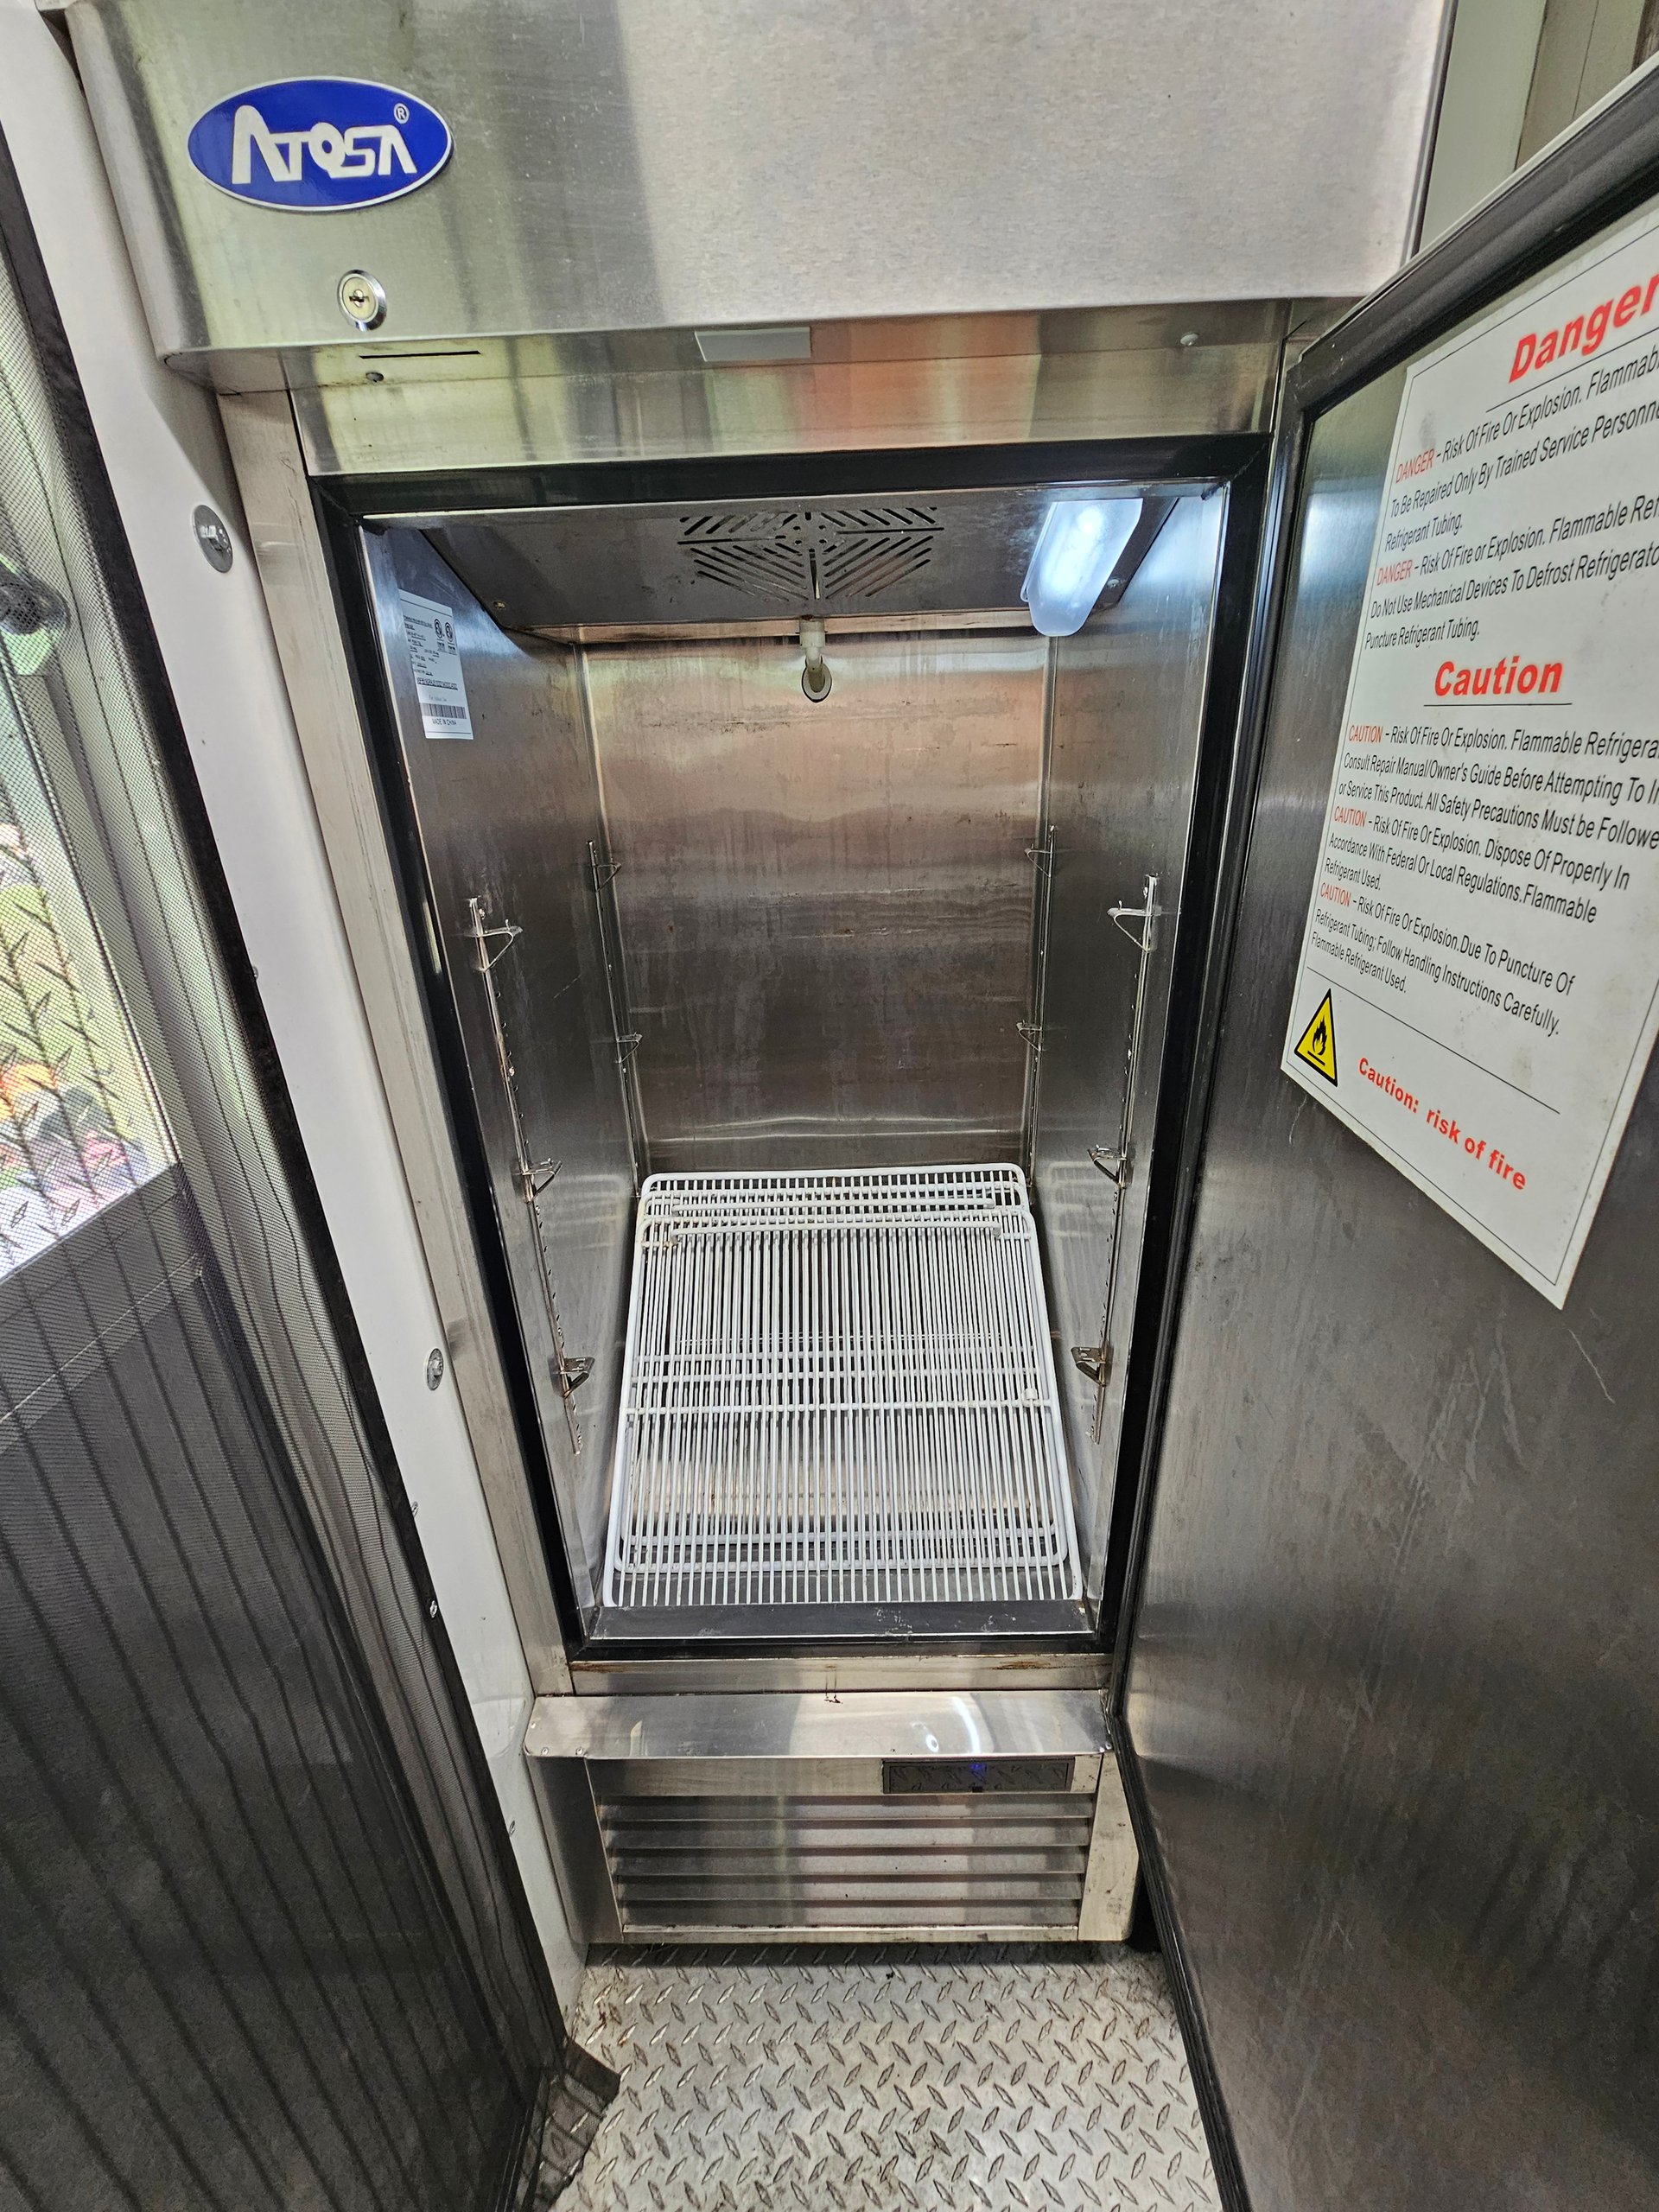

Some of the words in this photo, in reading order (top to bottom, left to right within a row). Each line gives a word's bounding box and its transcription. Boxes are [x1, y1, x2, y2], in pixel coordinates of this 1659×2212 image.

[232, 105, 417, 184] ATOSA
[1509, 273, 1659, 384] Danger
[1395, 448, 1435, 484] DANGER
[1442, 434, 1465, 462] Risk
[1465, 426, 1481, 452] Of
[1478, 421, 1501, 448] Fire
[1503, 410, 1517, 435] Or
[1517, 386, 1582, 429] Explosion.
[1586, 344, 1659, 399] Flammab
[1391, 499, 1400, 518] To
[1400, 494, 1411, 515] Be
[1413, 475, 1454, 511] Repaired
[1454, 467, 1478, 495] Only
[1478, 461, 1494, 489] By
[1495, 441, 1540, 480] Trained
[1540, 426, 1589, 462] Service
[1376, 559, 1413, 586] DANGER
[1420, 552, 1440, 576] Risk
[1441, 547, 1454, 570] Of
[1452, 544, 1473, 568] Fire
[1474, 543, 1487, 561] or
[1486, 526, 1545, 562] Explosion.
[1549, 500, 1628, 543] Flammable
[1384, 521, 1431, 552] Refrigerant
[1431, 512, 1462, 537] Tubing.
[1370, 601, 1382, 619] Do
[1382, 597, 1396, 616] Not
[1396, 594, 1413, 614] Use
[1413, 579, 1466, 611] Mechanical
[1465, 575, 1508, 601] Devices
[1511, 569, 1524, 593] To
[1526, 558, 1575, 589] Defrost
[1574, 540, 1659, 582] Refrigerato
[1364, 628, 1397, 650] Puncture
[1397, 620, 1446, 648] Refrigerant
[1446, 616, 1480, 642] Tubing.
[1434, 655, 1563, 696] Caution
[1348, 724, 1383, 743] CAUTION
[1390, 726, 1409, 745] Risk
[1409, 726, 1422, 745] Of
[1421, 726, 1440, 746] Fire
[1441, 728, 1453, 747] Or
[1453, 728, 1508, 753] Explosion.
[1510, 728, 1583, 754] Flammable
[1338, 782, 1347, 795] or
[1346, 780, 1372, 800] Service
[1374, 784, 1389, 804] This
[1389, 786, 1423, 810] Product.
[1425, 791, 1440, 812] All
[1439, 793, 1471, 822] Safety
[1471, 798, 1540, 830] Precautions
[1541, 809, 1576, 836] Must
[1576, 813, 1595, 838] be
[1597, 817, 1659, 850] Followe
[1344, 752, 1370, 772] Consult
[1370, 755, 1397, 777] Repair
[1395, 756, 1468, 783] Manual/Owner's
[1470, 763, 1502, 786] Guide
[1503, 766, 1544, 791] Before
[1543, 770, 1624, 806] Attempting
[1627, 777, 1645, 803] To
[1324, 857, 1361, 883] Refrigerant
[1361, 868, 1381, 891] Used.
[1329, 832, 1368, 857] Accordance
[1368, 842, 1385, 863] With
[1385, 847, 1419, 872] Federal
[1418, 855, 1430, 874] Or
[1430, 858, 1457, 883] Local
[1333, 806, 1367, 828] CAUTION
[1373, 815, 1390, 836] Risk
[1391, 818, 1402, 837] Of
[1402, 820, 1419, 842] Fire
[1420, 824, 1433, 844] Or
[1432, 827, 1481, 856] Explosion.
[1484, 837, 1531, 867] Dispose
[1534, 849, 1553, 872] Of
[1550, 852, 1613, 892] Properly
[1613, 865, 1630, 891] In
[1311, 931, 1344, 960] Flammable
[1344, 948, 1384, 982] Refrigerant
[1384, 967, 1407, 994] Used.
[1315, 908, 1350, 937] Refrigerant
[1376, 936, 1403, 961] Follow
[1402, 946, 1441, 983] Handling
[1441, 963, 1502, 1007] Instructions
[1503, 992, 1560, 1037] Carefully.
[1319, 882, 1351, 907] CAUTION
[1357, 895, 1374, 917] Risk
[1375, 902, 1386, 920] Of
[1384, 906, 1400, 927] Fire
[1402, 912, 1414, 931] Or
[1484, 943, 1497, 965] To
[1497, 949, 1554, 988] Puncture
[1555, 971, 1576, 996] Of
[1359, 1057, 1419, 1114] Caution:
[1426, 1109, 1461, 1145] risk
[1464, 1137, 1486, 1160] of
[1488, 1149, 1527, 1190] fire
